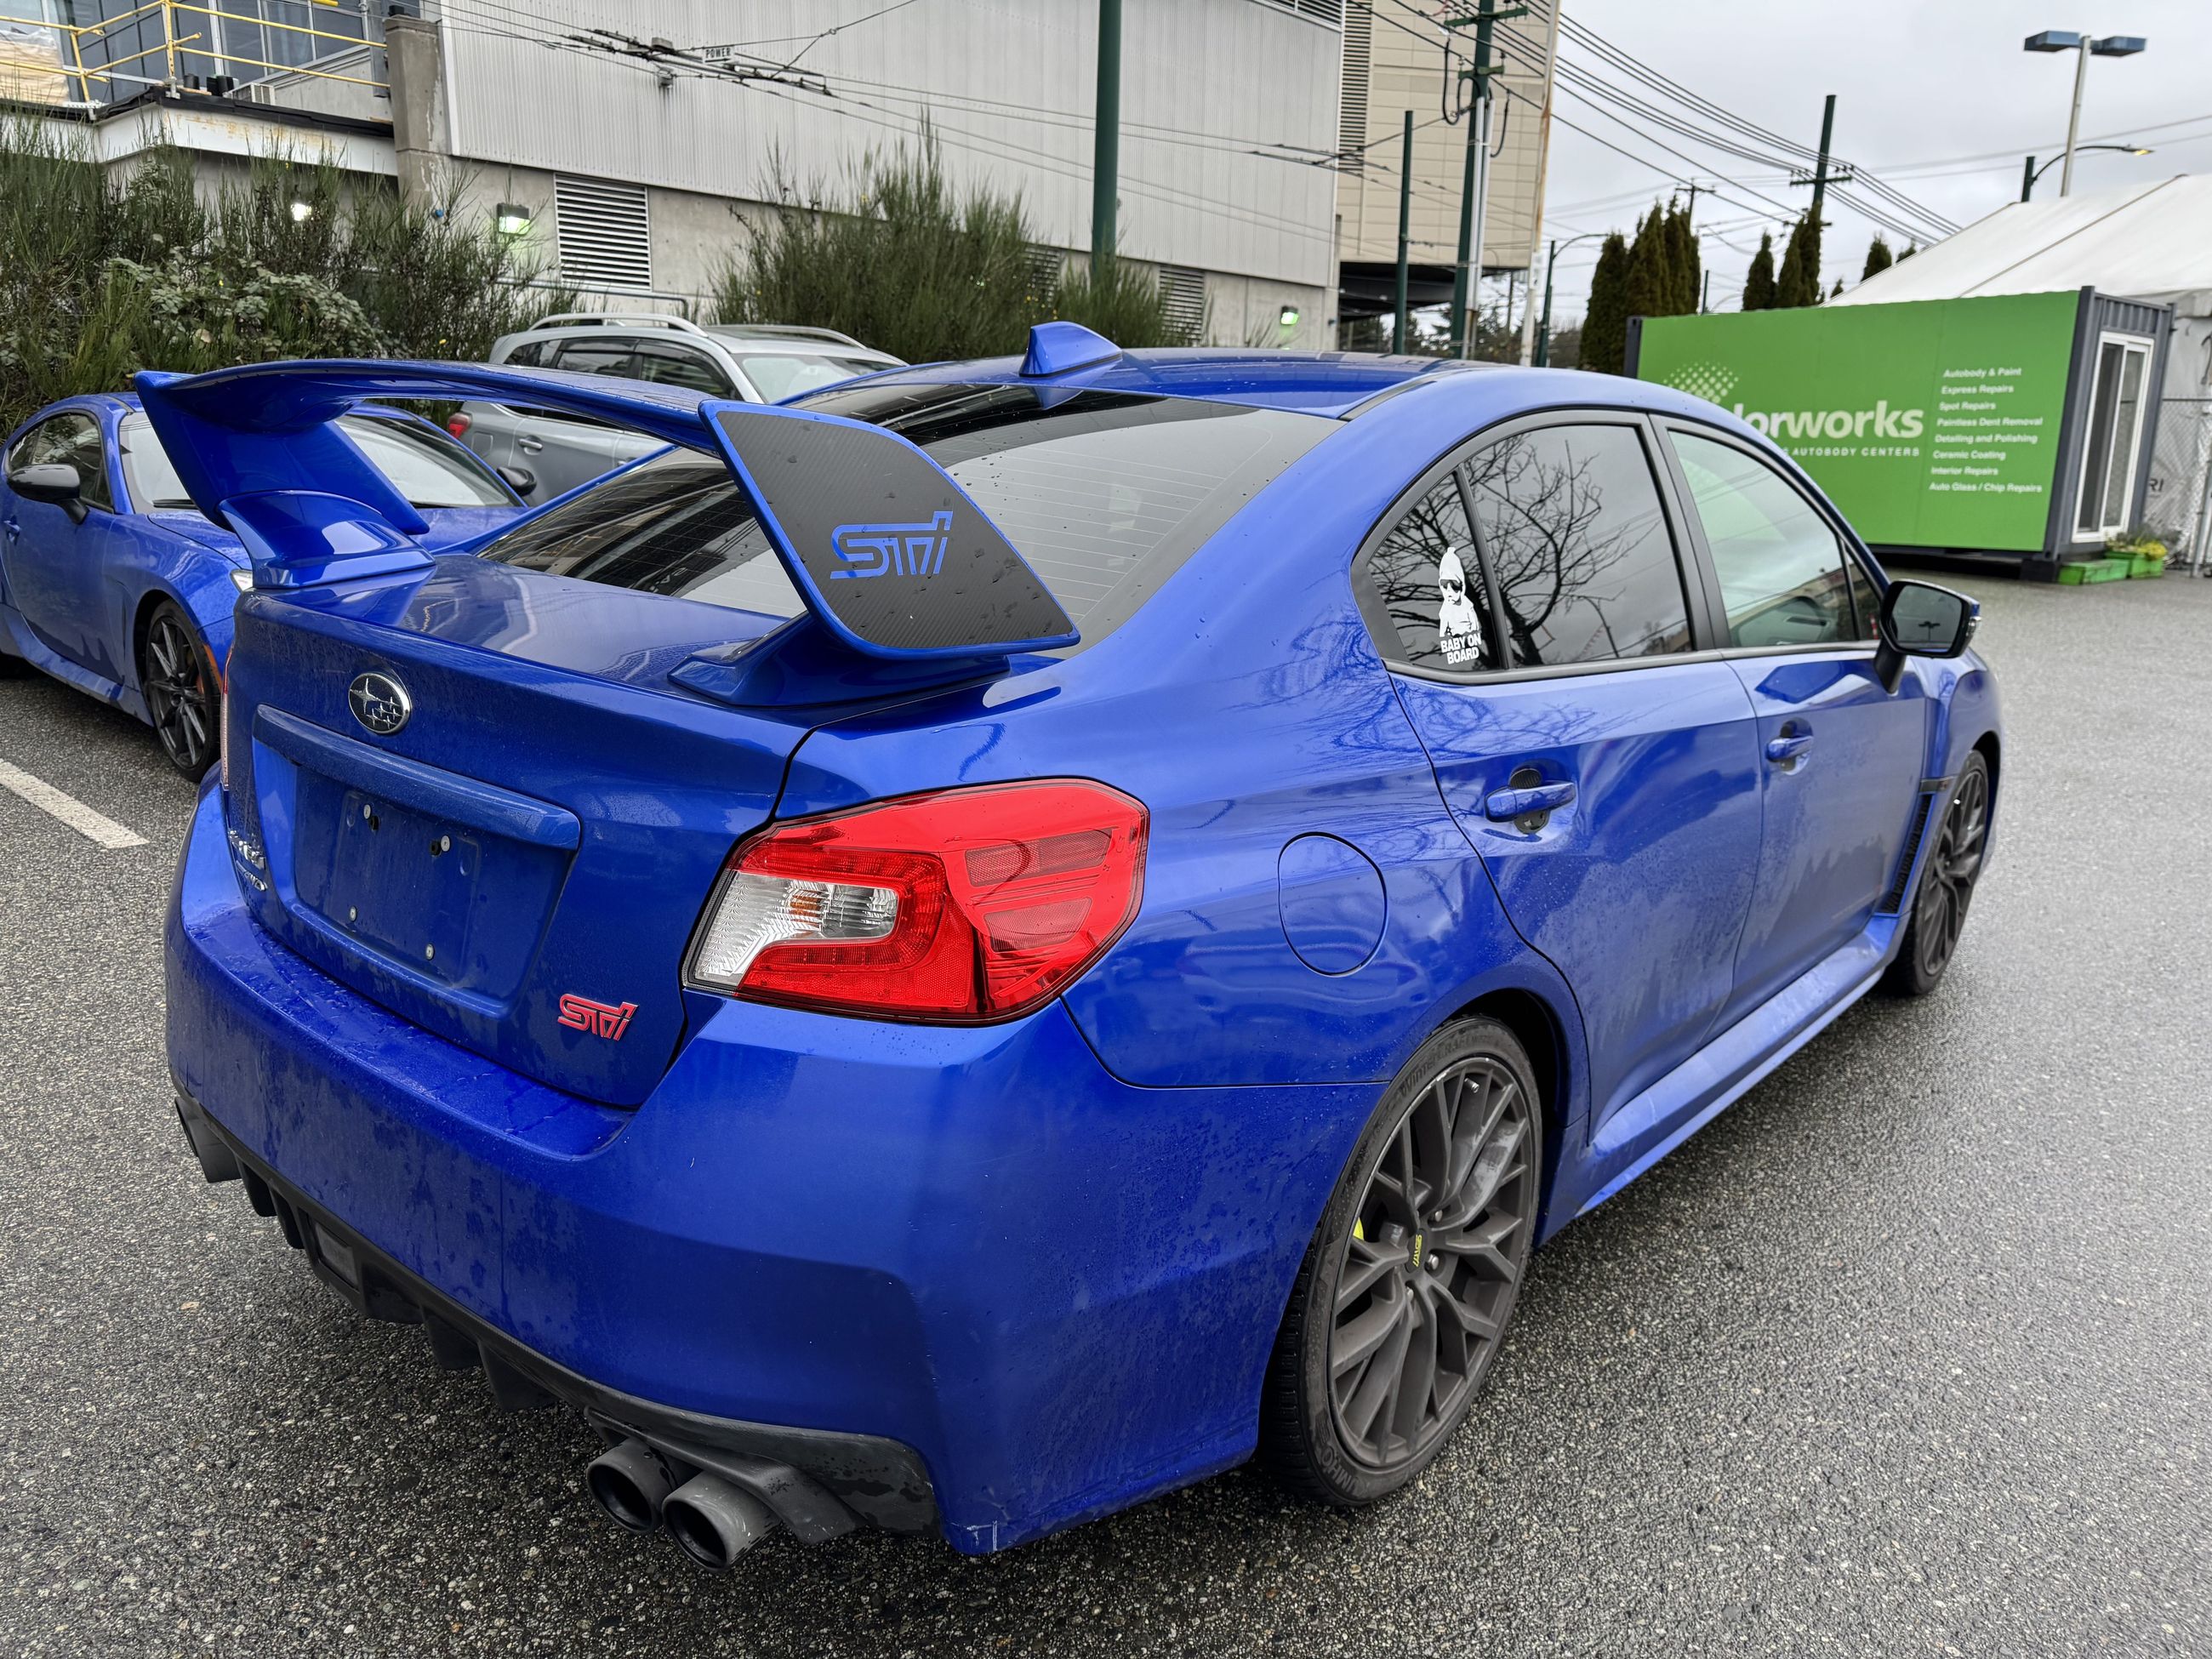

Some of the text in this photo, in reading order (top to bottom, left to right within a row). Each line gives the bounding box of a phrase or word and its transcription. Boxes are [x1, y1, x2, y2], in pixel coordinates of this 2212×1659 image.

[705, 48, 730, 58] POWER
[1943, 368, 1987, 379] Autobody
[1998, 367, 2022, 376] Paint
[1941, 384, 2015, 395] Express Repairs
[1940, 401, 1997, 412] Spot Repairs
[1936, 416, 2044, 426] Paintless Dent Removal
[1935, 433, 2038, 444] Detailing and Polishing
[1792, 447, 1857, 456] AUTOBODY
[1861, 447, 1920, 456] CENTERS
[1932, 449, 2006, 460] Ceramic Coating
[1930, 465, 1999, 476] Interior Repairs
[1929, 482, 1951, 491] Auto
[1951, 482, 1977, 492] Glass
[1983, 482, 2005, 493] Chip
[2006, 482, 2043, 493] Repairs
[1440, 633, 1482, 653] BABY ON
[1447, 647, 1479, 664] BOARD
